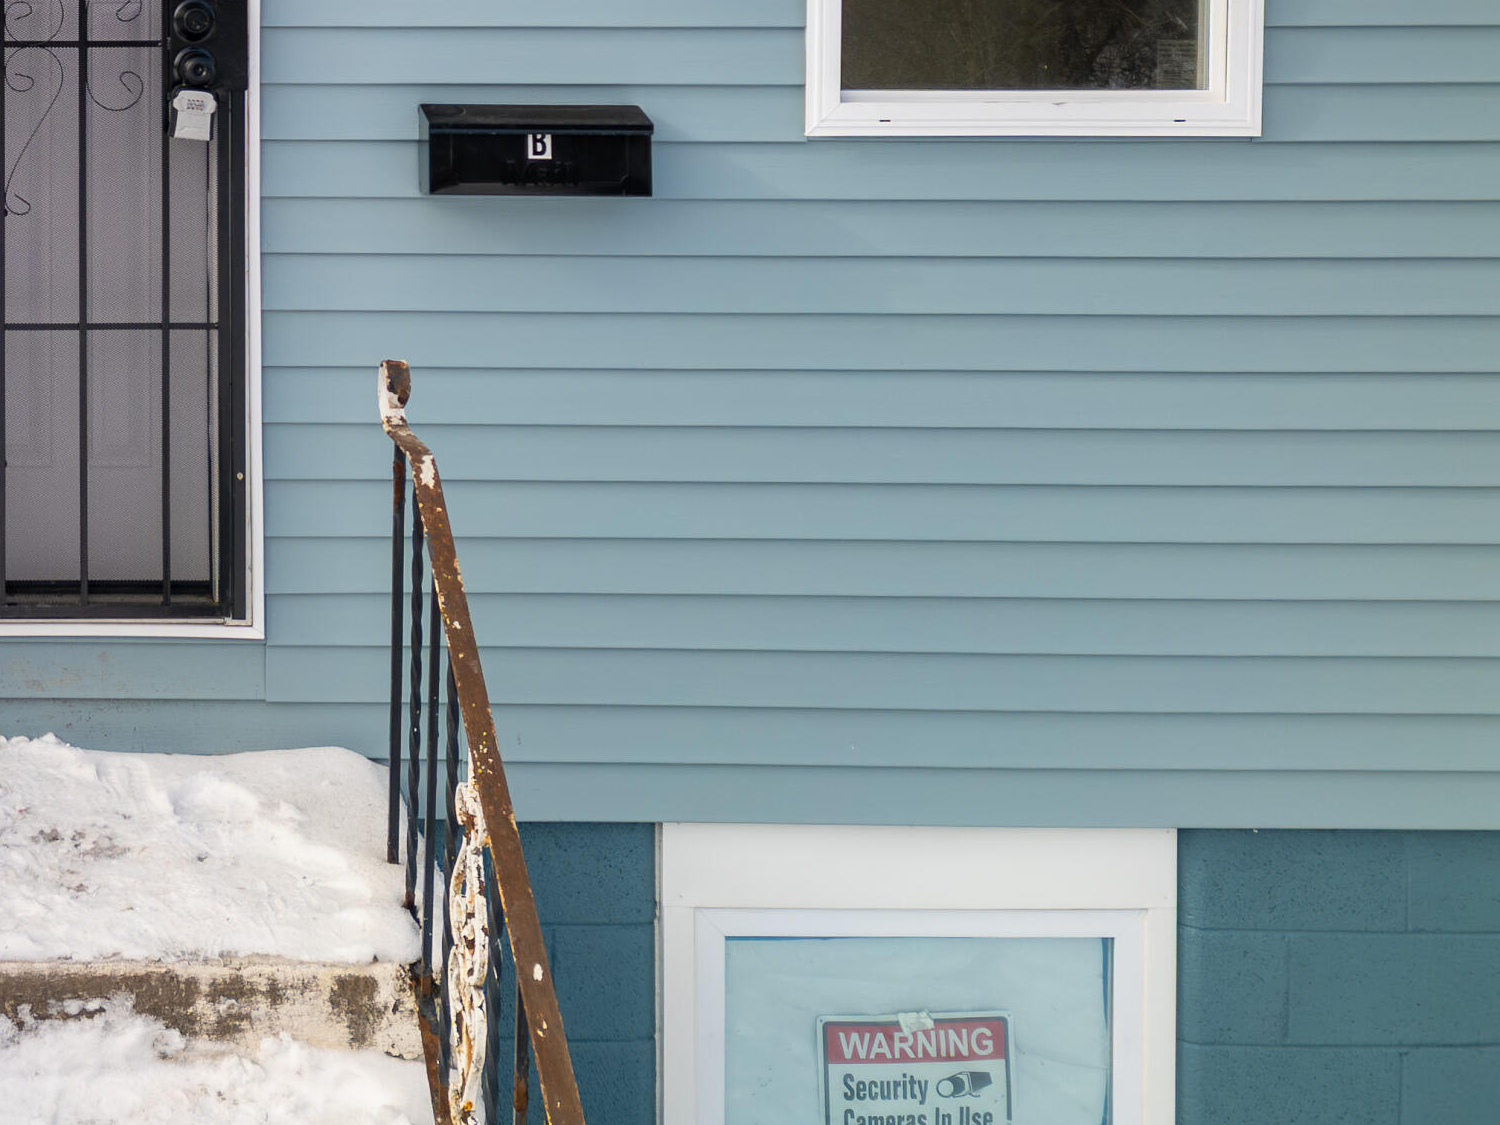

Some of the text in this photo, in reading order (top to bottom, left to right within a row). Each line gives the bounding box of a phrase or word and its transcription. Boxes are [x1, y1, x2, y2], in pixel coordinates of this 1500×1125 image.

[532, 133, 547, 156] B
[838, 1027, 994, 1060] WARNING
[843, 1073, 929, 1105] Security
